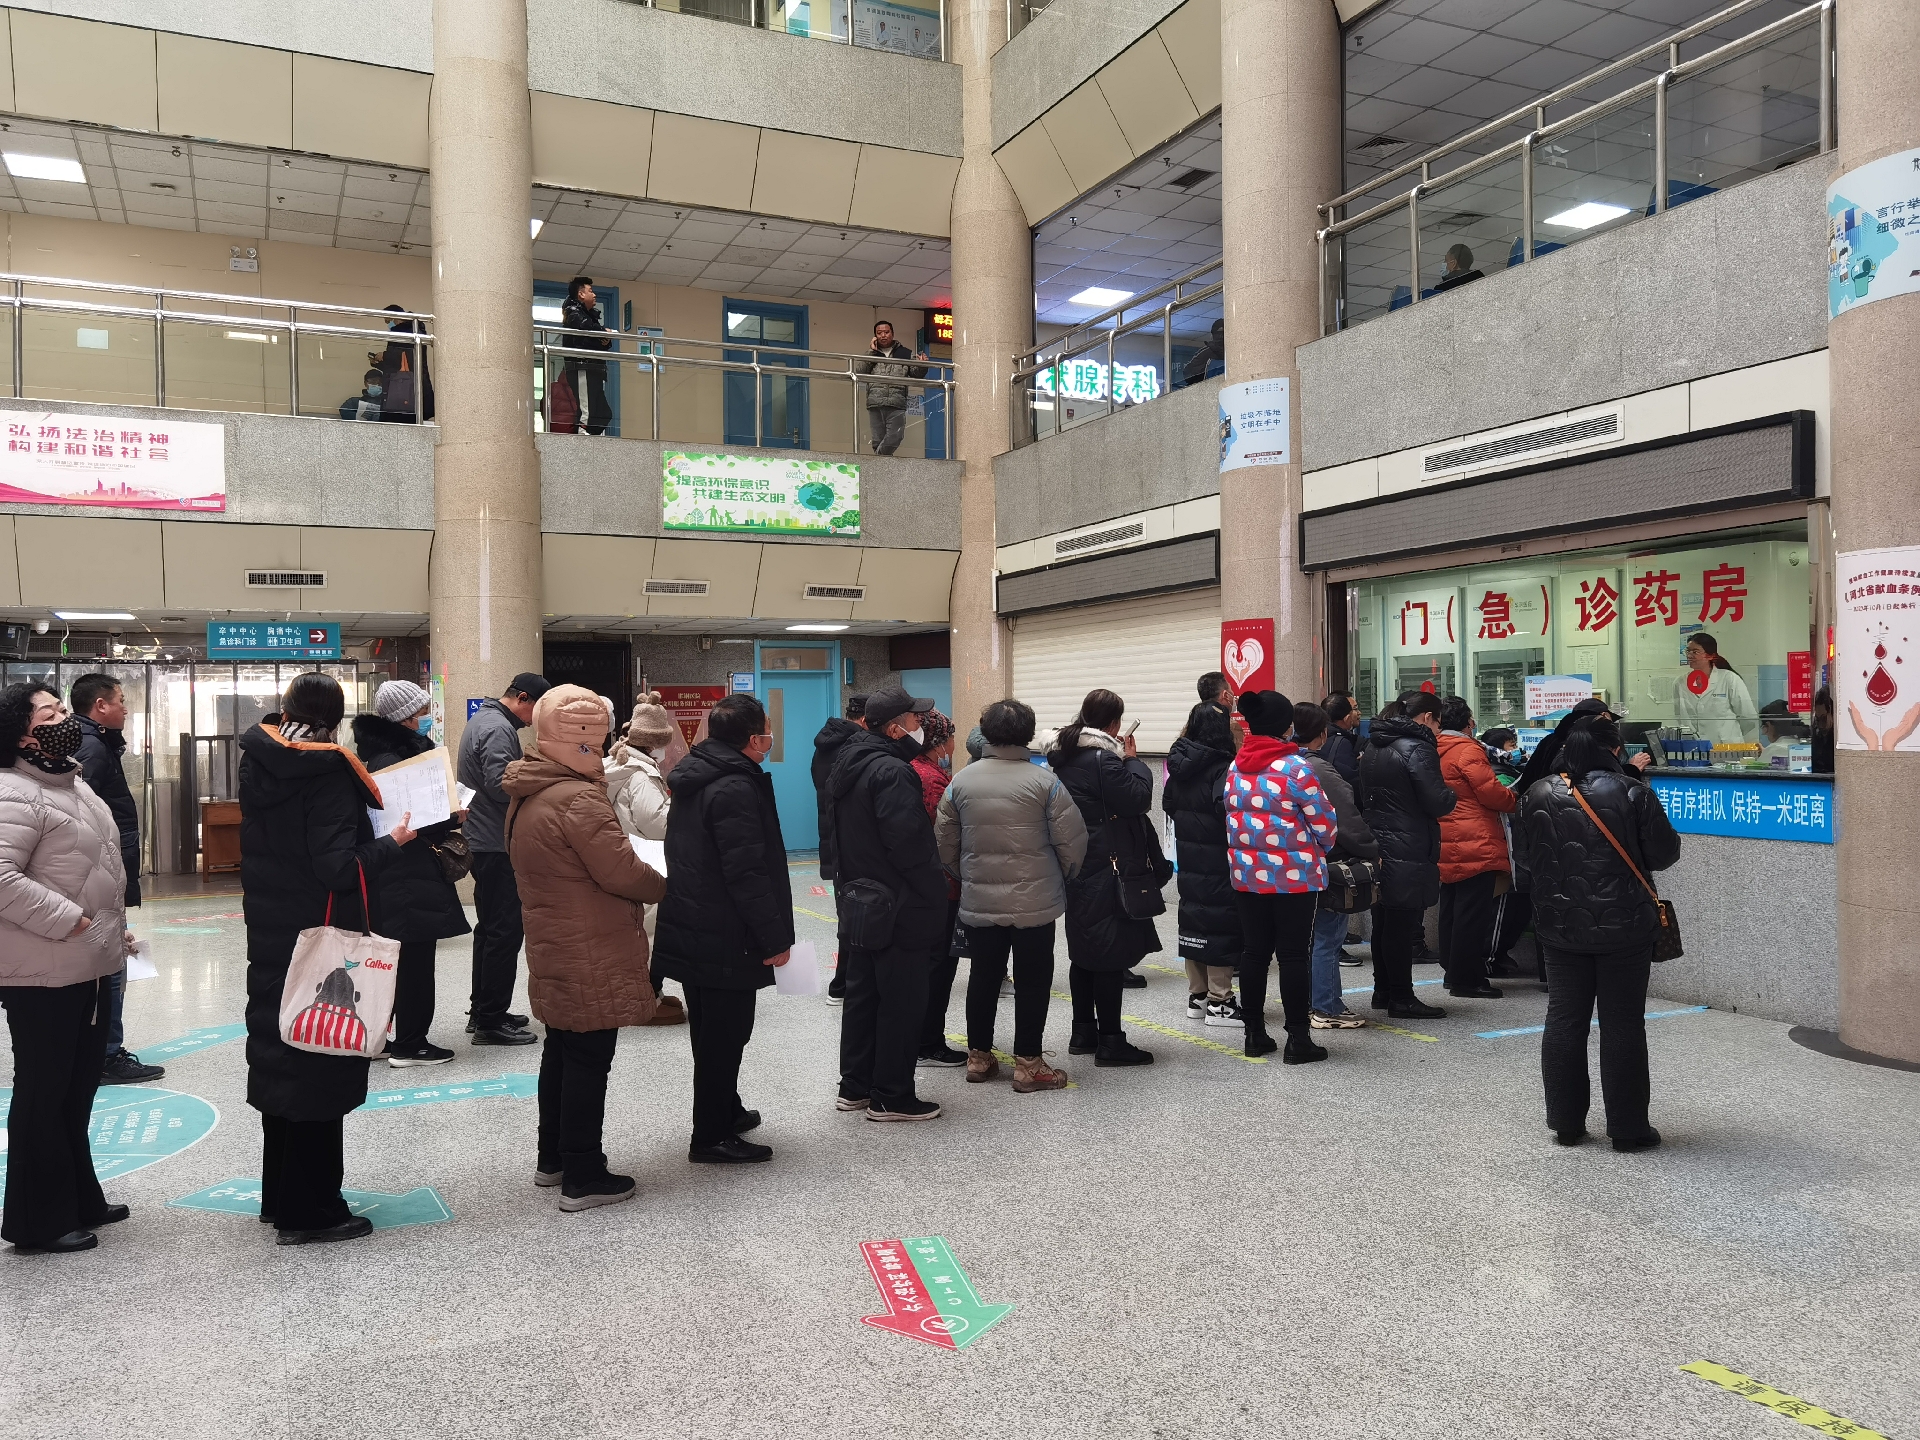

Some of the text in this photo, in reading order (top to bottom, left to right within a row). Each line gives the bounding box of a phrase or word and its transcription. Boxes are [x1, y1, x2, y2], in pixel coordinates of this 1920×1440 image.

[1240, 409, 1281, 420] 垃圾不落地
[1240, 418, 1281, 430] 文明在手中
[8, 423, 169, 446] 弘扬法治精神
[8, 439, 169, 461] 构建和谐社会
[676, 475, 770, 490] 提高环保意识
[692, 488, 786, 503] 共建生态文明
[218, 626, 302, 636] 卒中中心 胸痛中心
[219, 637, 302, 646] 急诊科门诊 卫生间
[1656, 786, 1826, 829] 请有序排队 保持一米距离
[364, 957, 393, 971] Calbee
